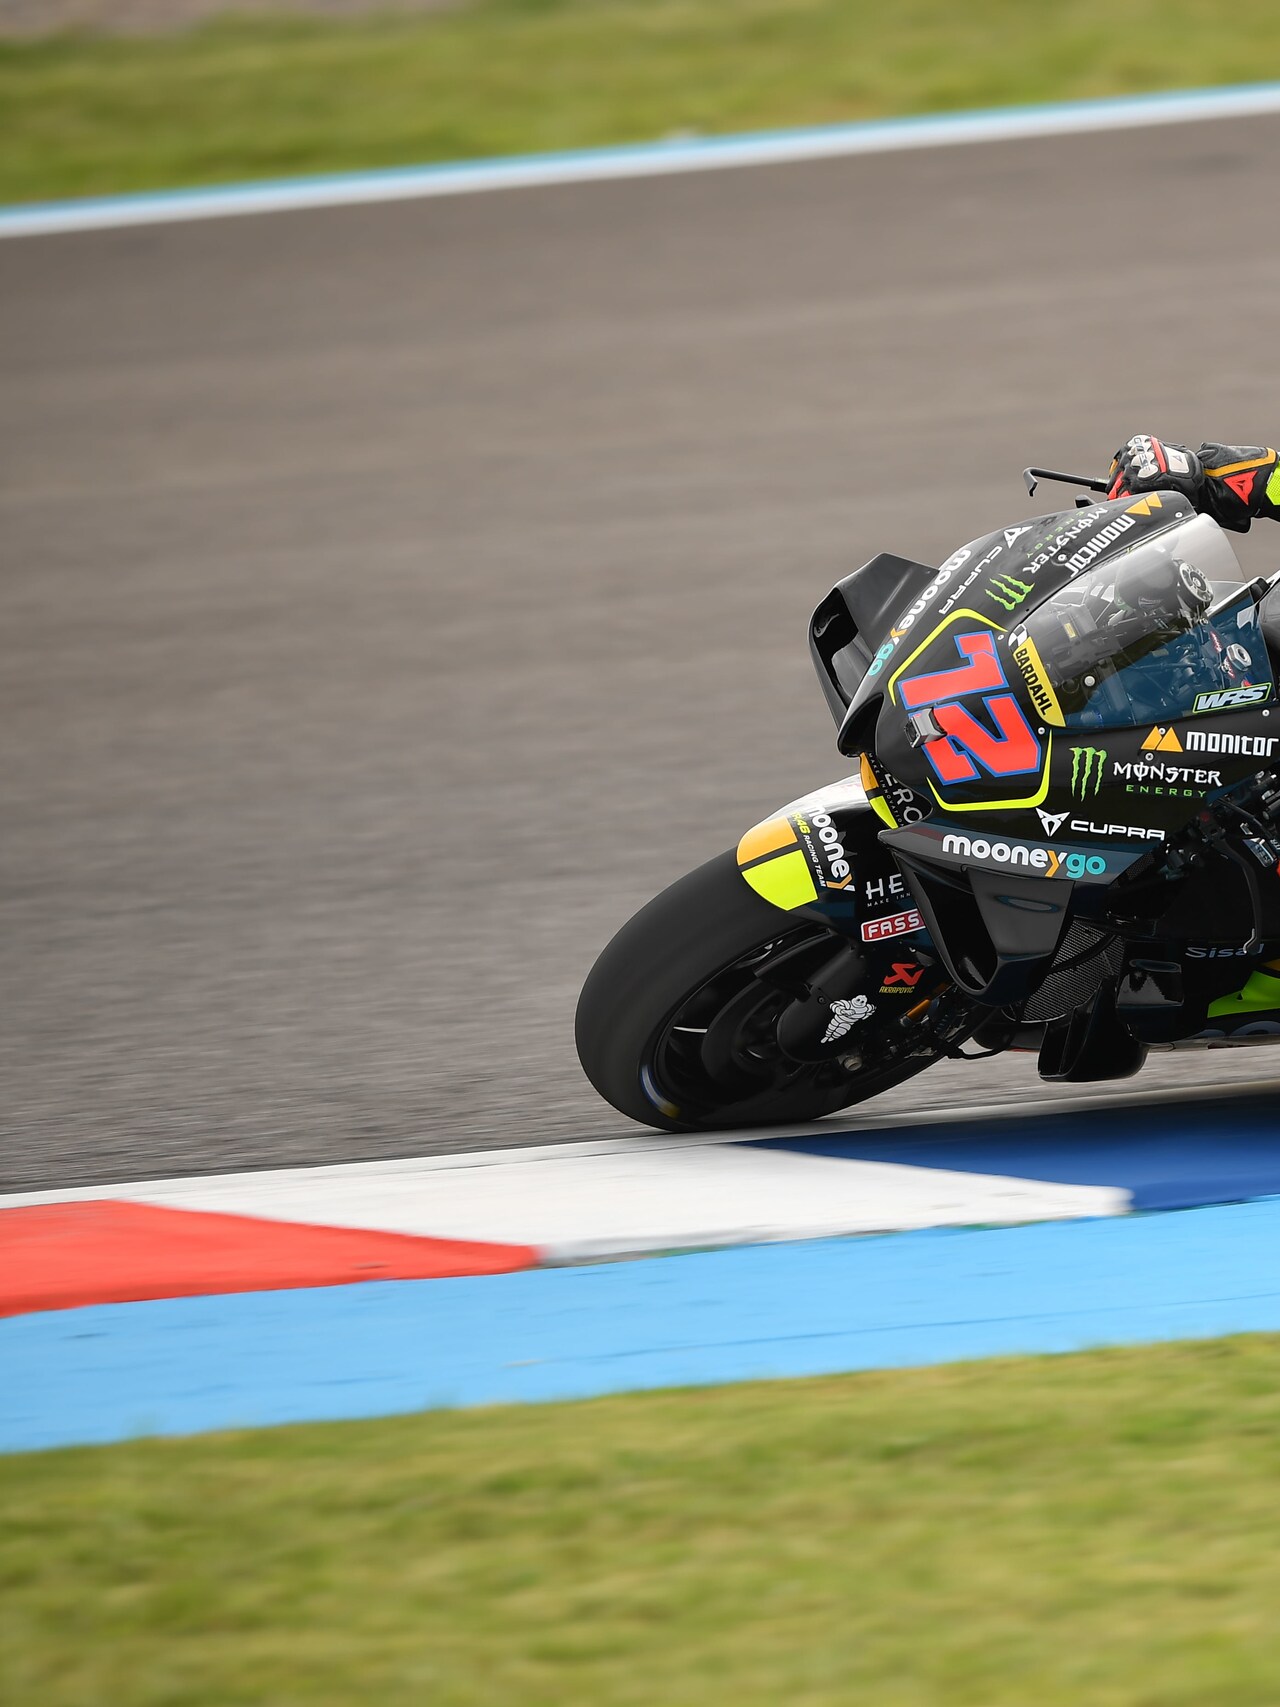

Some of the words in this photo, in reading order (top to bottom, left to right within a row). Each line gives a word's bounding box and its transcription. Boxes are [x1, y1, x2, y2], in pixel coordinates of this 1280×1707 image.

[937, 546, 1003, 615] CUPRA
[1015, 647, 1053, 716] BARDAHL
[1197, 685, 1268, 711] WRS
[1113, 760, 1223, 787] MONSTER
[1125, 784, 1207, 798] ENERGY
[1070, 819, 1166, 841] CUPRA
[803, 834, 819, 863] RACING
[815, 863, 827, 887] TEAM
[942, 834, 1107, 879] mooneygo
